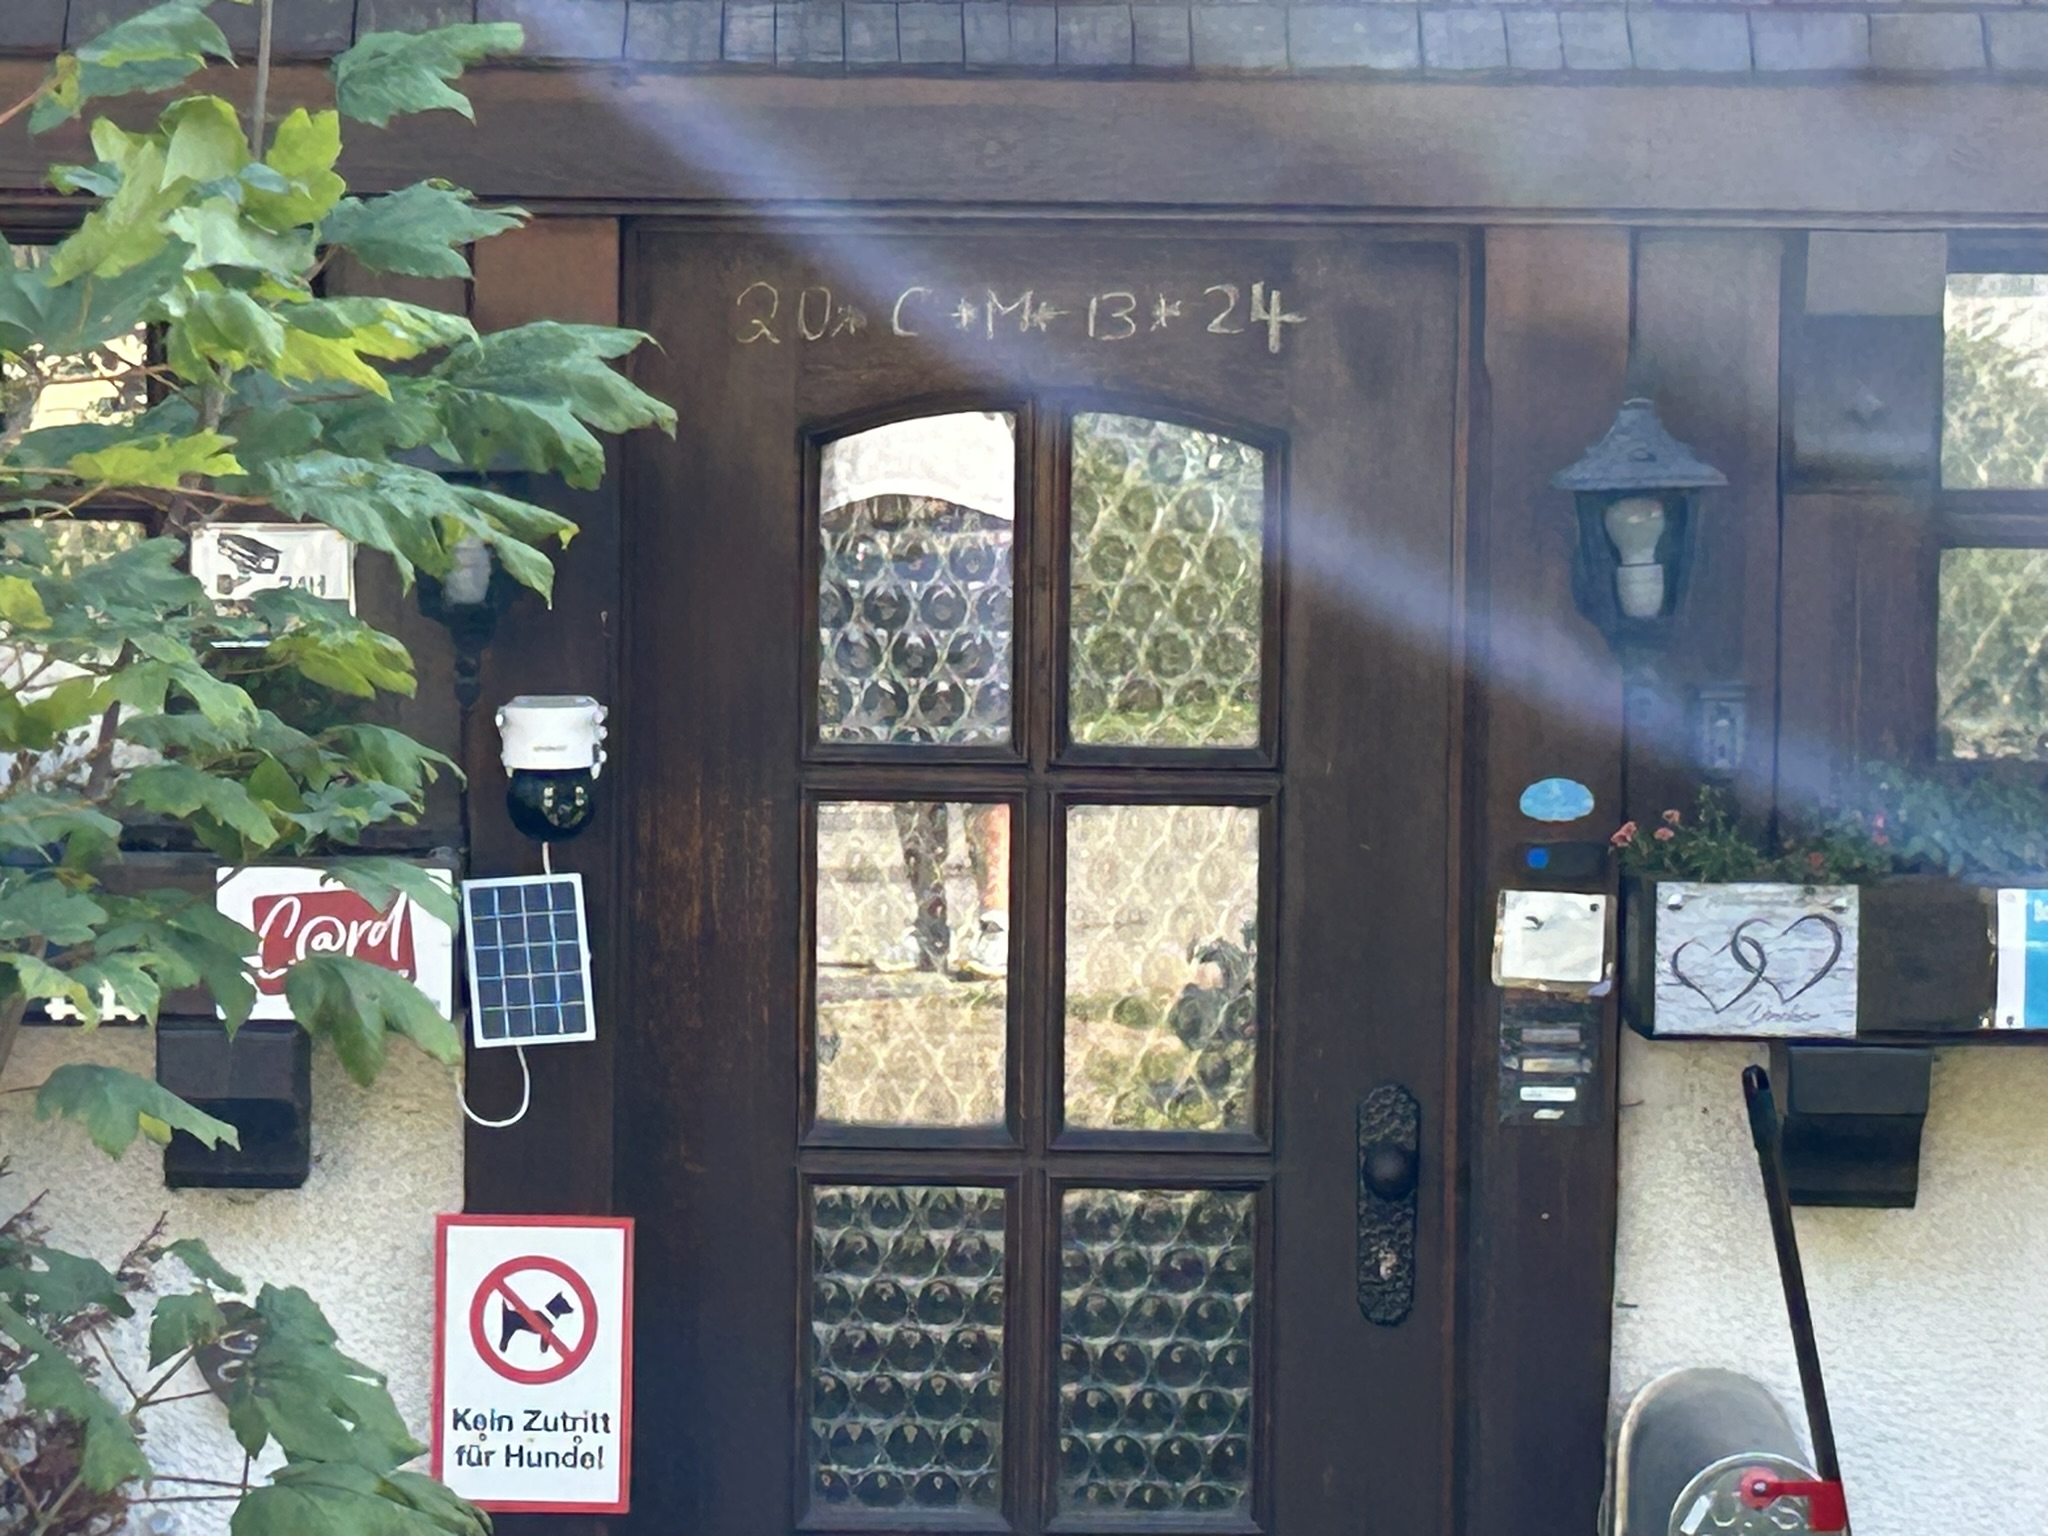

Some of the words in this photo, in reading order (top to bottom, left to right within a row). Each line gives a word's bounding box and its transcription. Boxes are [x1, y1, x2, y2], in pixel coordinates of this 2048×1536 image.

[1203, 279, 1307, 355] 24
[452, 1407, 514, 1433] Kein
[523, 1409, 611, 1434] Zutritt
[455, 1444, 496, 1467] für
